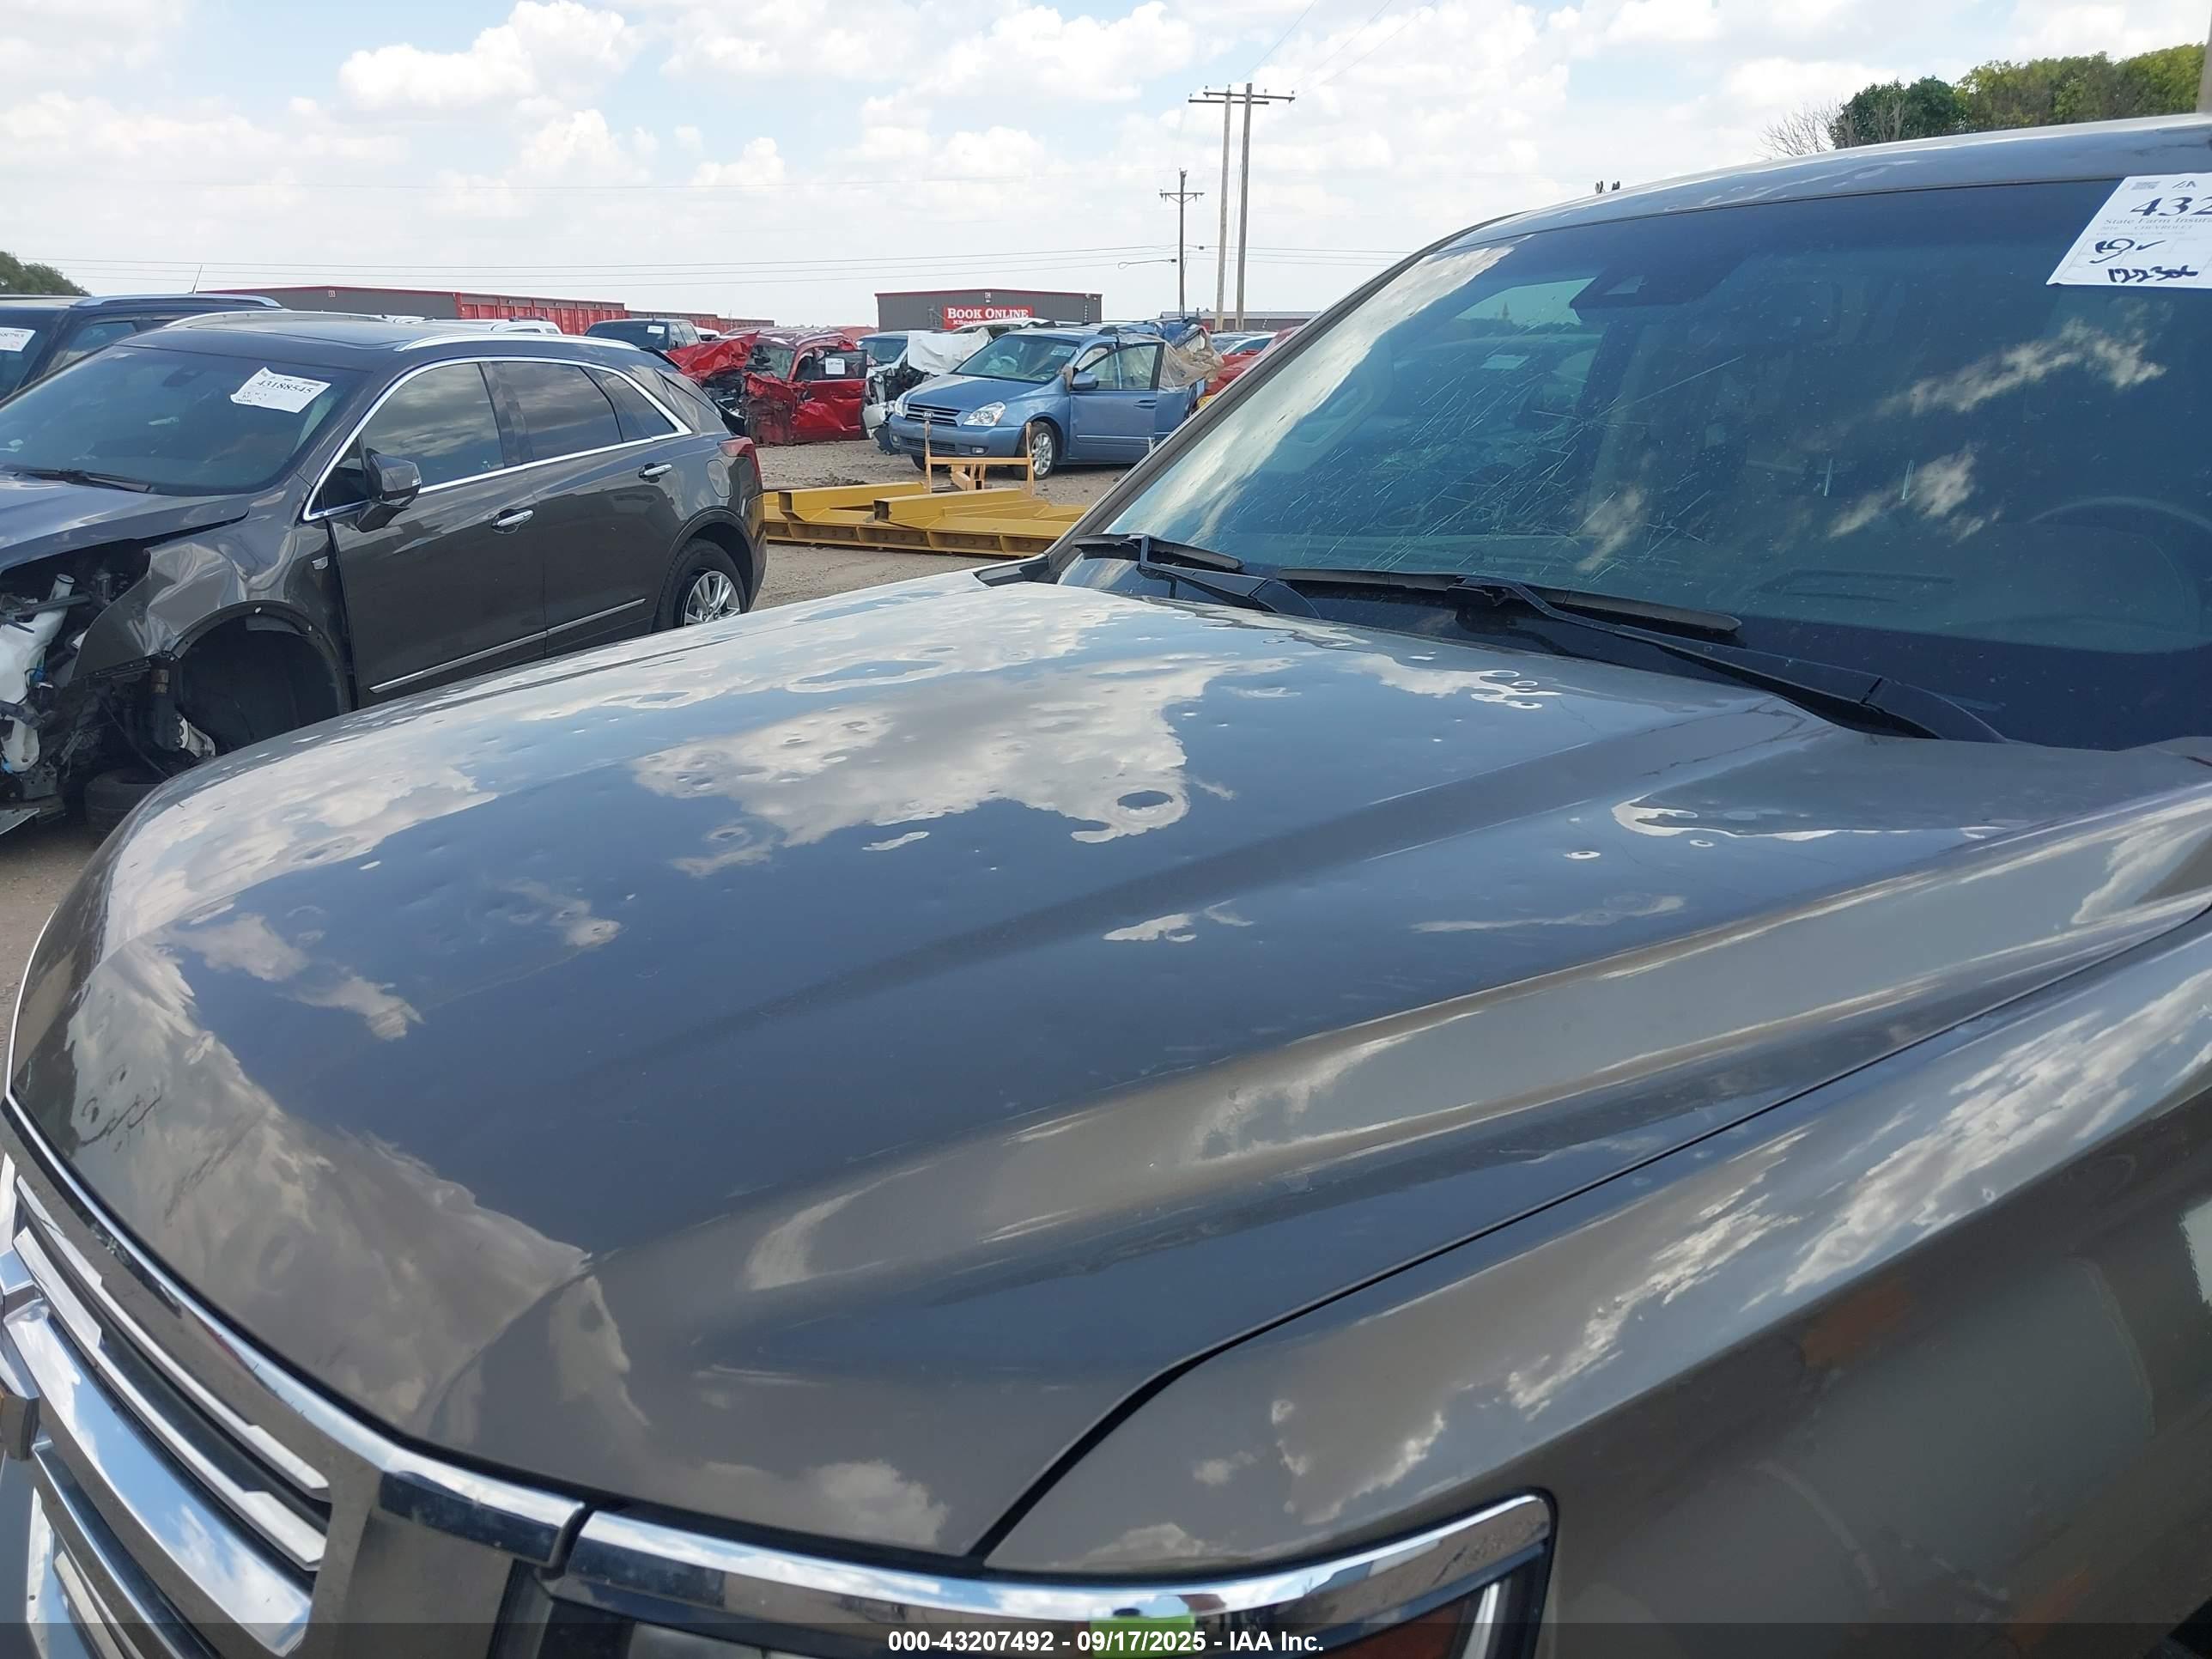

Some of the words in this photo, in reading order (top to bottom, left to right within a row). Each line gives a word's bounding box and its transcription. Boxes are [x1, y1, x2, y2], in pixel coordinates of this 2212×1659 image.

[2130, 197, 2212, 216] 432
[947, 308, 982, 319] BOOK
[985, 307, 1029, 319] ONLINE
[257, 380, 314, 394] 43188545
